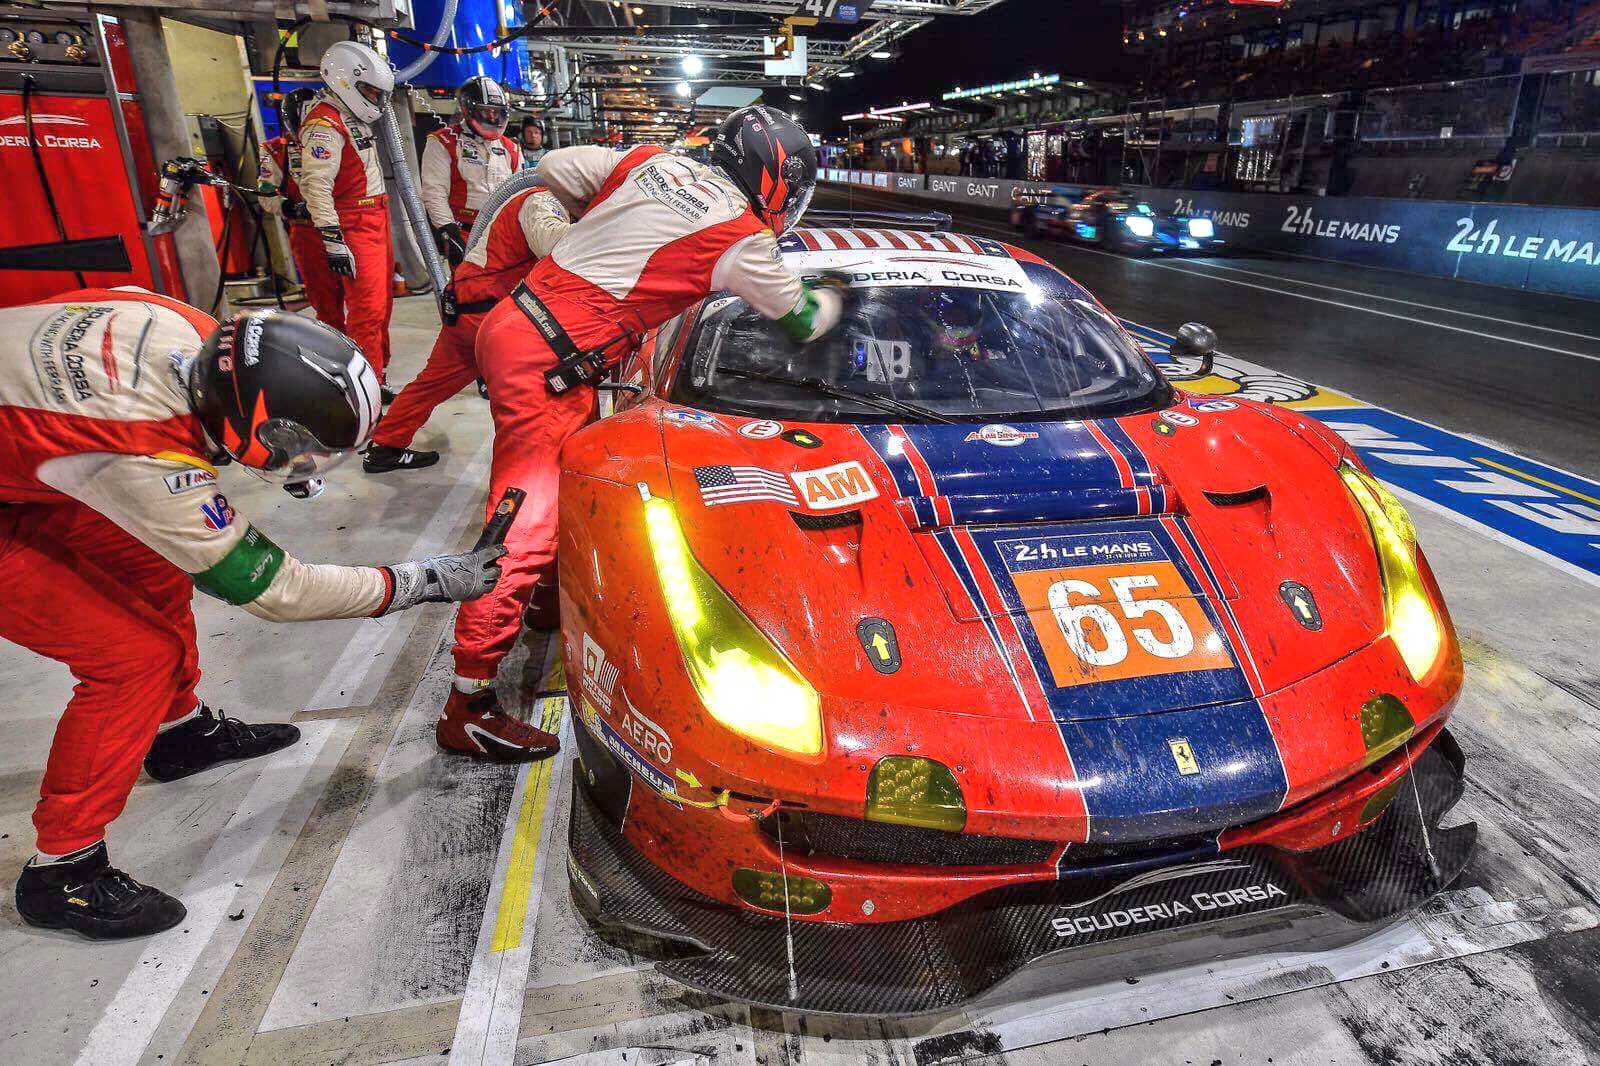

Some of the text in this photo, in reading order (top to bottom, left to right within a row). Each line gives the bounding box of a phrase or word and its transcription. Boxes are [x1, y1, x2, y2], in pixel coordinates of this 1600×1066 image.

[44, 135, 102, 148] CORSA
[898, 177, 918, 189] GANT
[932, 179, 958, 193] GANT
[967, 183, 999, 199] GANT
[672, 199, 703, 220] FERRARI
[676, 188, 709, 214] CORSA
[1210, 210, 1250, 229] MANS
[1316, 220, 1341, 237] LE
[1340, 222, 1400, 244] MANS
[1503, 235, 1544, 259] LE
[1544, 238, 1600, 266] MA
[942, 270, 1022, 288] CORSA
[66, 354, 93, 402] CORSA
[806, 467, 870, 502] AM
[1062, 546, 1089, 557] LE
[1091, 542, 1150, 555] MANS
[1047, 574, 1194, 666] 65
[622, 713, 672, 764] AERO
[608, 735, 677, 795] MICHELIN
[1051, 882, 1287, 937] SCUDERIA CORSA
